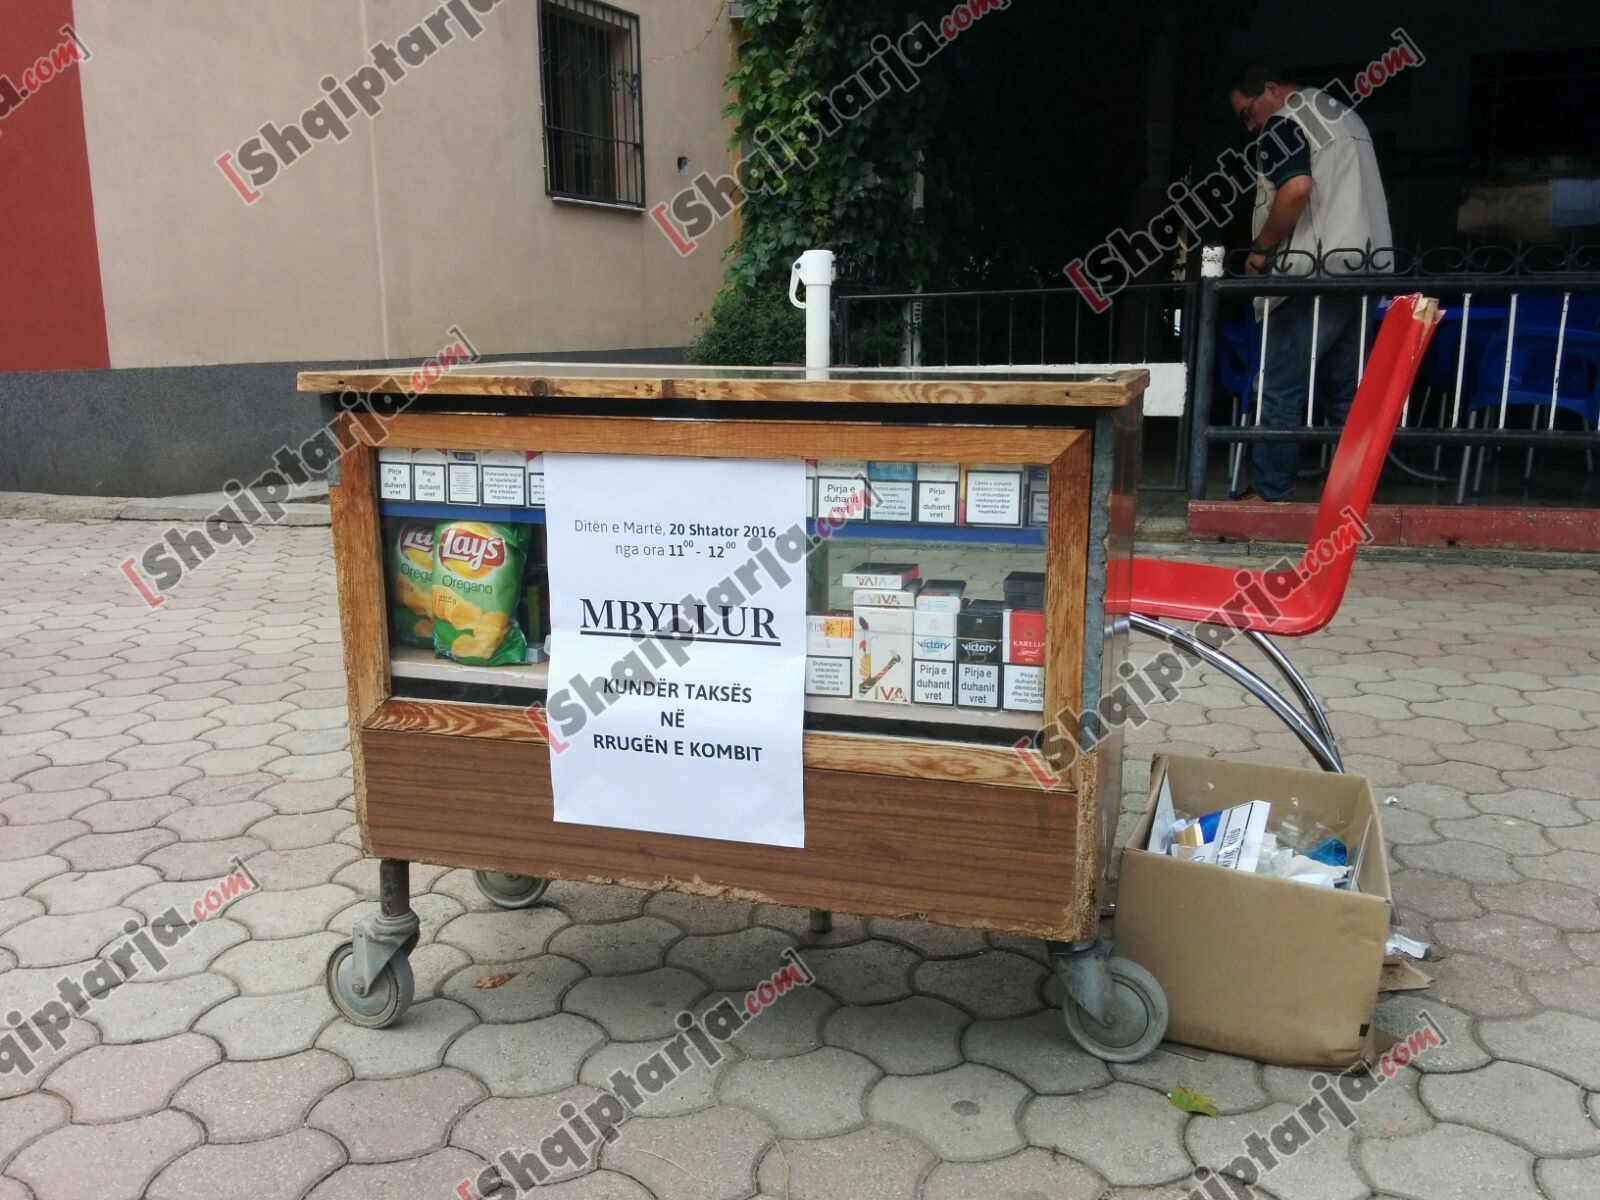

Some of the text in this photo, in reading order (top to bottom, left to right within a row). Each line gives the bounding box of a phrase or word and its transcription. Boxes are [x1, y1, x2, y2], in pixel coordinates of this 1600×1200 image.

[827, 484, 848, 494] Pirja
[929, 487, 946, 496] Pirja
[823, 495, 859, 504] duhanit
[831, 505, 850, 513] vret
[923, 503, 951, 511] duhanit
[574, 519, 608, 534] Ditën
[612, 524, 620, 534] e
[669, 523, 686, 536] 20
[689, 523, 740, 538] Shtator
[615, 545, 639, 558] nga
[643, 546, 665, 557] ora
[441, 574, 493, 594] Oregano
[579, 598, 781, 639] MBYLLUR
[961, 643, 997, 653] victory
[920, 664, 940, 675] Pirja
[964, 667, 985, 679] Pirja
[603, 677, 752, 704] KUNDËR TAKSËS
[917, 680, 950, 690] duhanit
[961, 681, 995, 693] duhanit
[925, 692, 942, 700] vret
[969, 694, 987, 704] vret
[661, 708, 685, 728] NË
[593, 734, 763, 762] RRUGËN E KOMBIT
